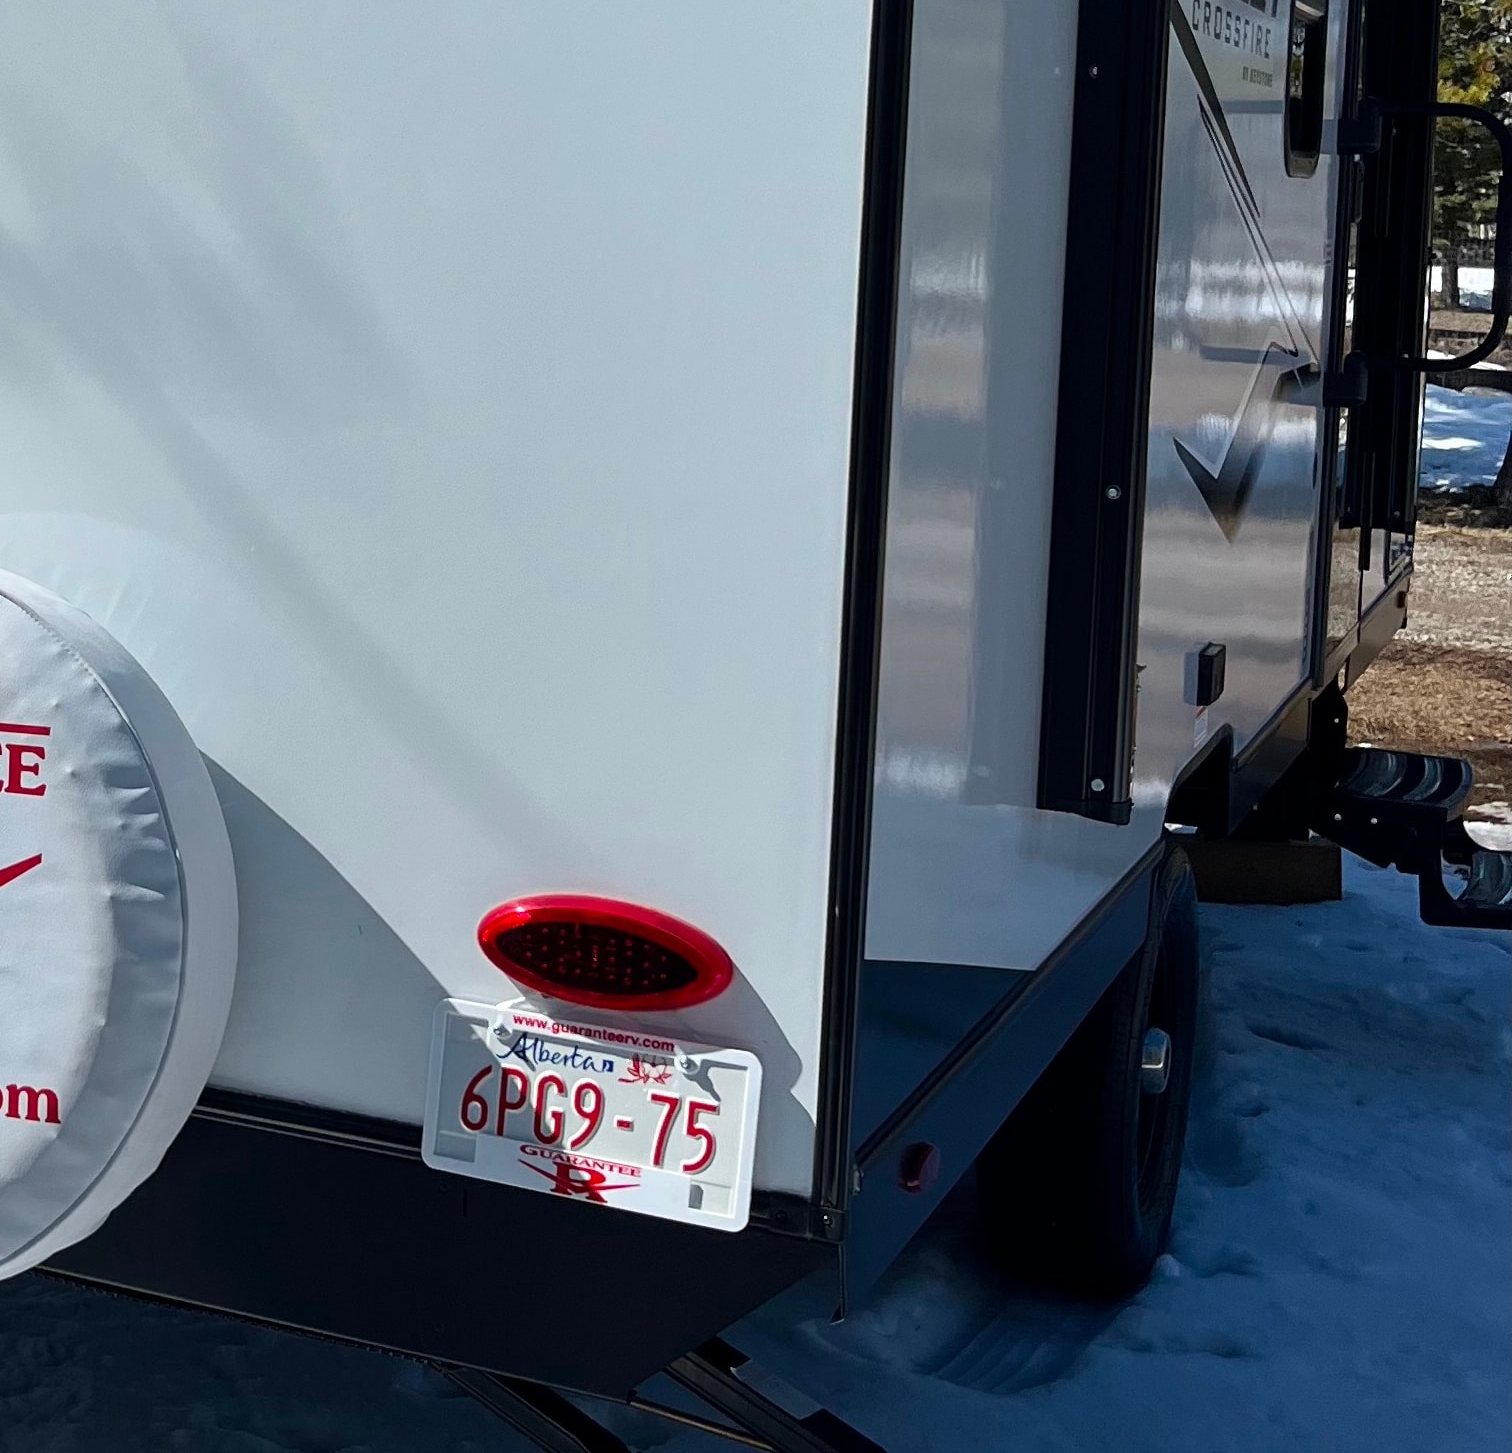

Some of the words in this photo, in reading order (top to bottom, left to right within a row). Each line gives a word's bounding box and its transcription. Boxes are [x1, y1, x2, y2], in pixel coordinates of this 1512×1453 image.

[495, 1031, 604, 1073] Alberta
[512, 1013, 676, 1053] www.guaranteerv.com
[519, 1144, 642, 1177] GUARANTEE
